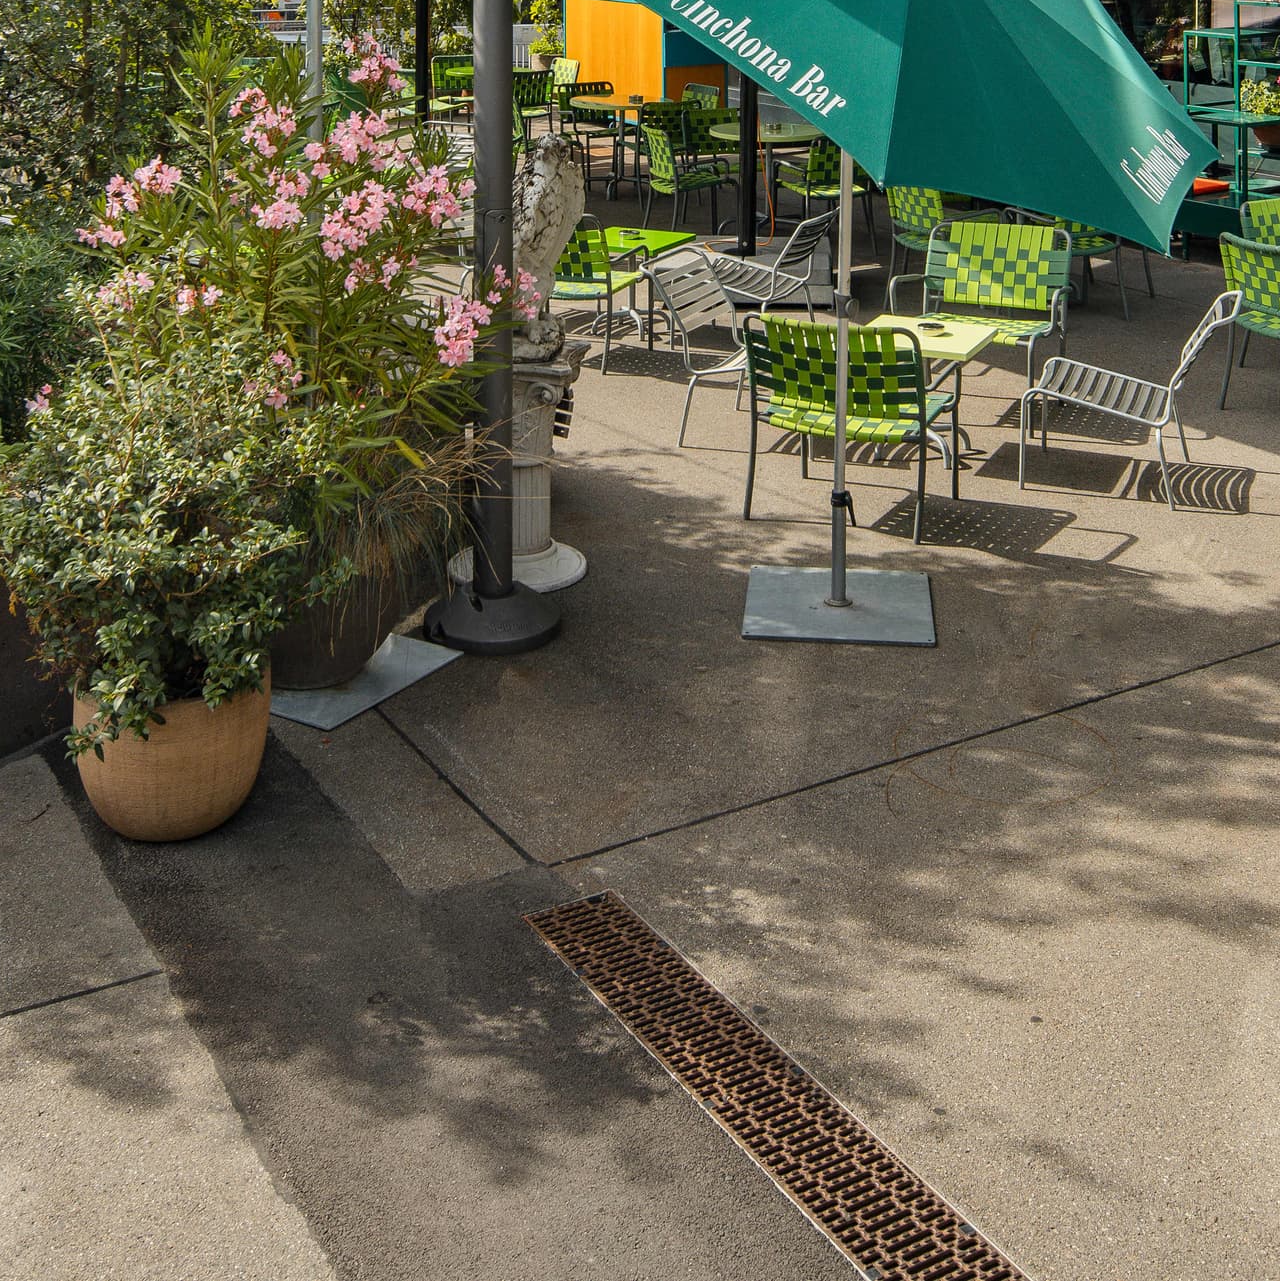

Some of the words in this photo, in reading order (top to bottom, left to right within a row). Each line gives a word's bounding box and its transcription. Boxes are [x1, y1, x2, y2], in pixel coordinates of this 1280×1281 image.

[787, 64, 847, 118] Bar
[1146, 125, 1191, 166] Bar
[1120, 145, 1181, 205] Cinchona
